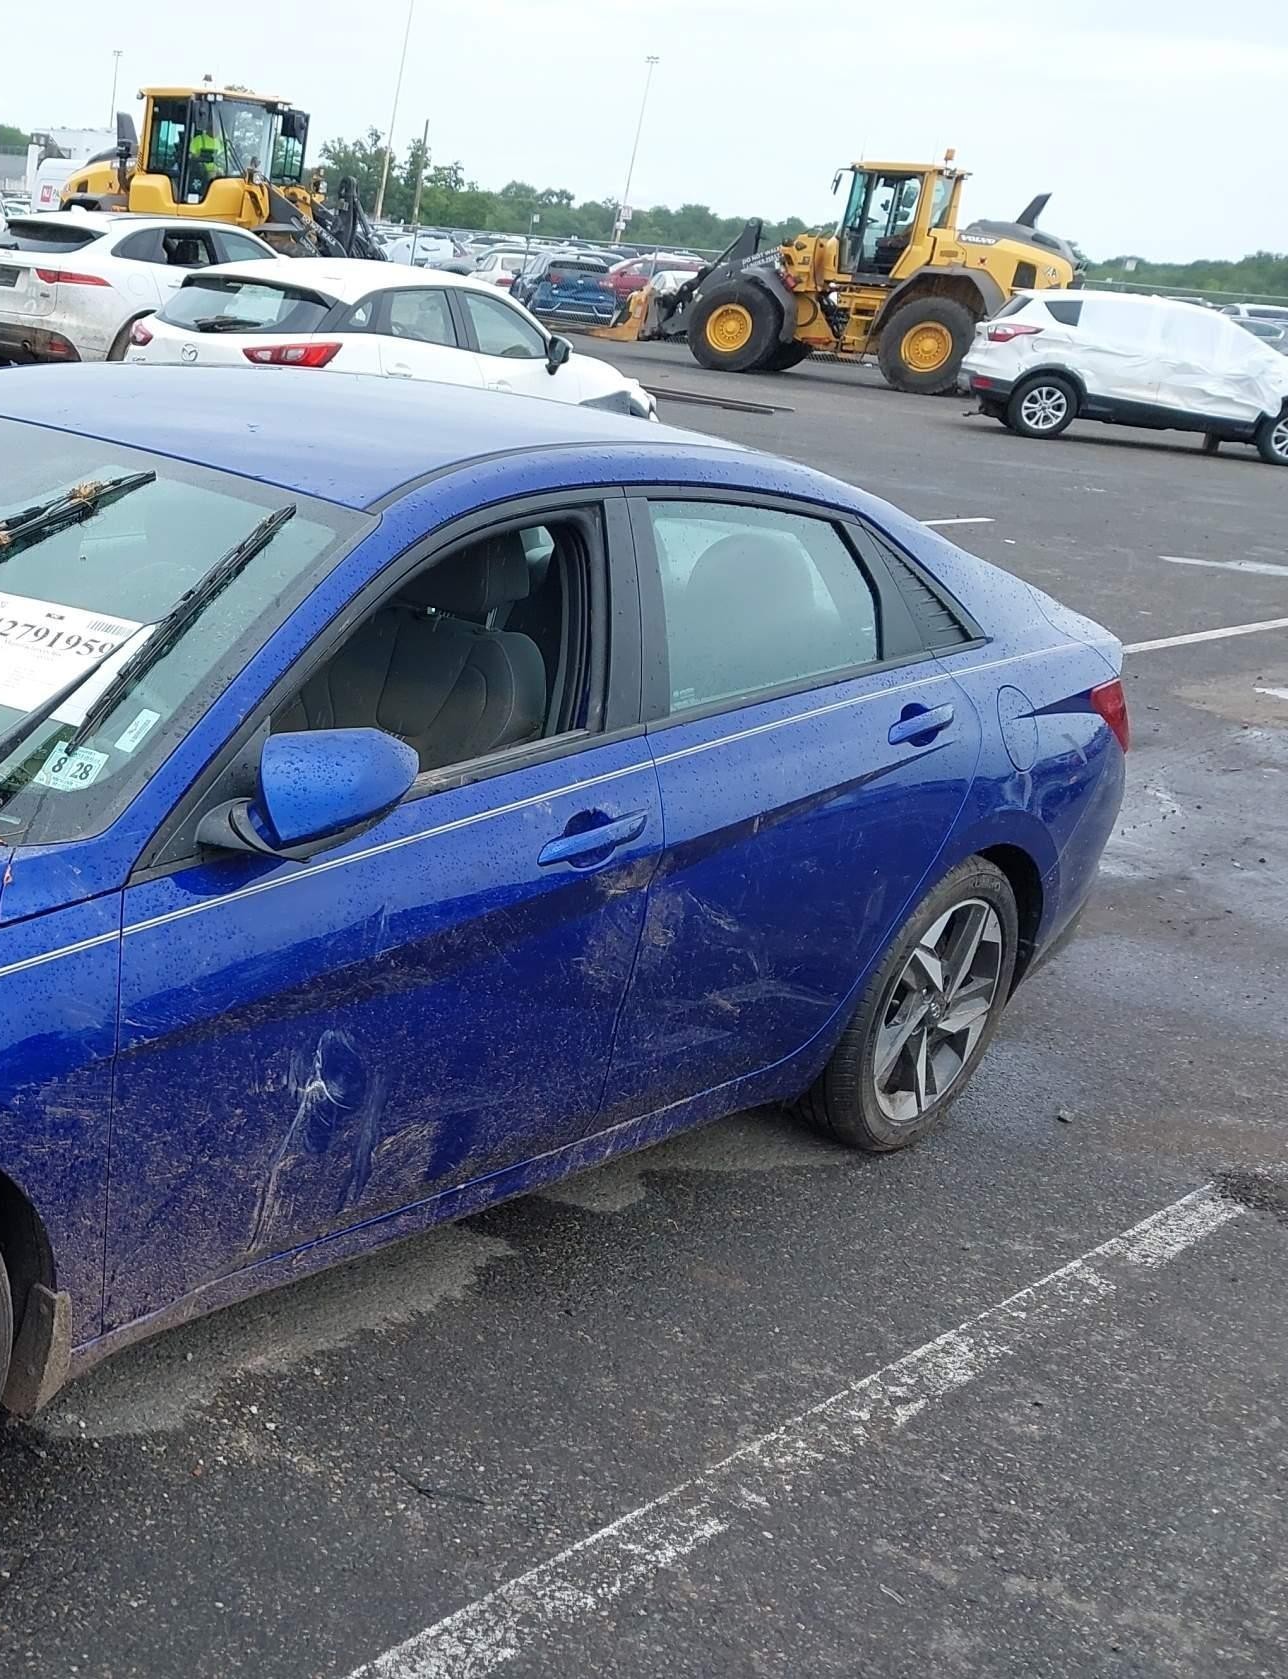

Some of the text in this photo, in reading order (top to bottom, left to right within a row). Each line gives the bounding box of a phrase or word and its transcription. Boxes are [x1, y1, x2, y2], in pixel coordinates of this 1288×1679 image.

[960, 234, 996, 244] VOLVO
[51, 757, 93, 780] 8 28
